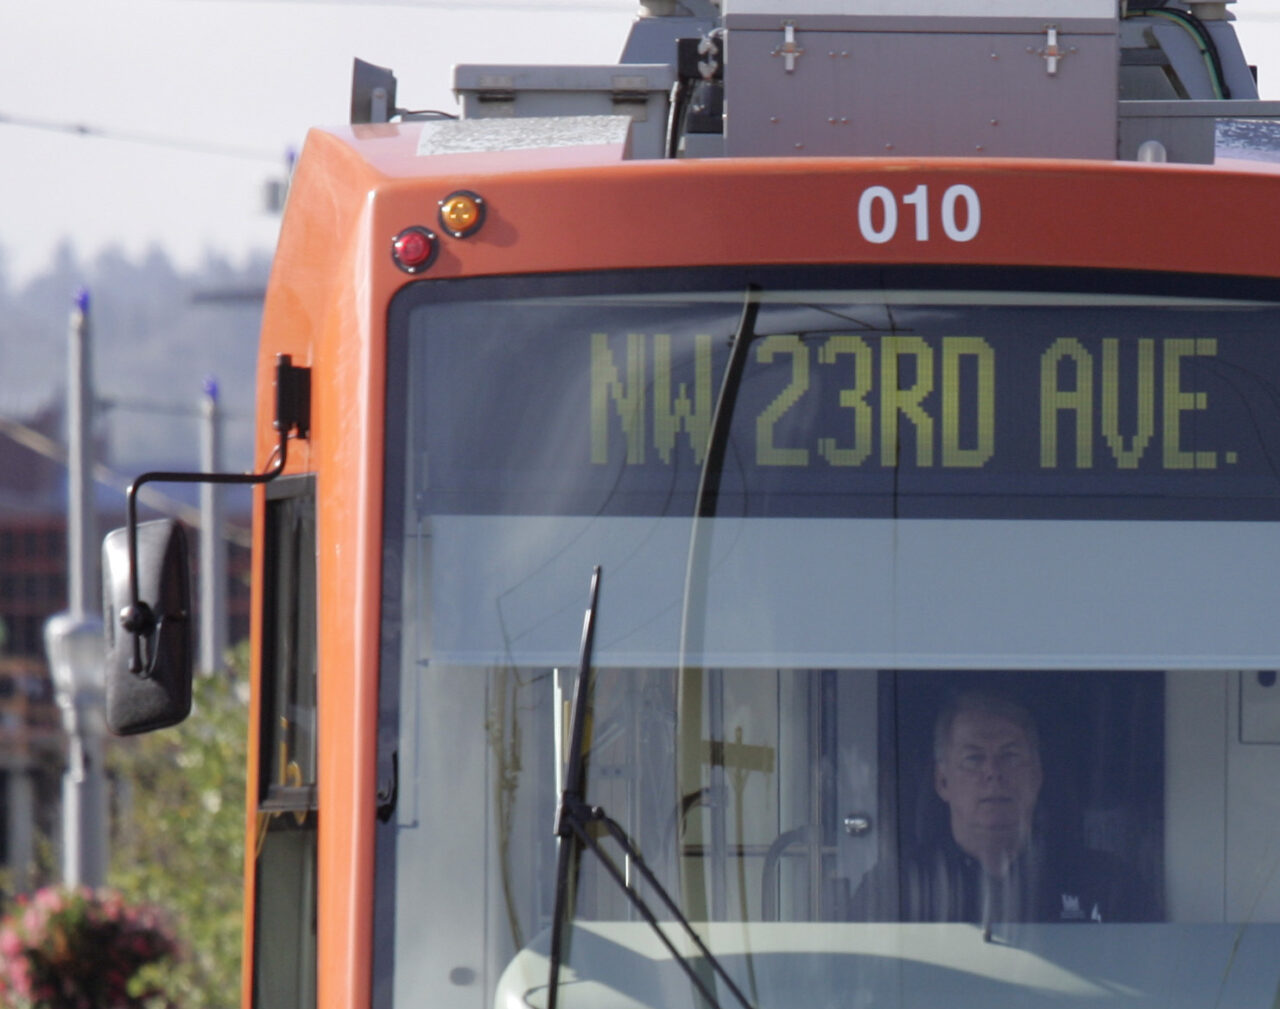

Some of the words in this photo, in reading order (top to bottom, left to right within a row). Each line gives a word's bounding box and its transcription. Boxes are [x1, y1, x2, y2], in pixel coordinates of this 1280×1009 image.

[857, 184, 982, 244] 010
[590, 333, 712, 466] NW
[756, 335, 995, 467] 23RD
[1040, 337, 1239, 470] AVE.
